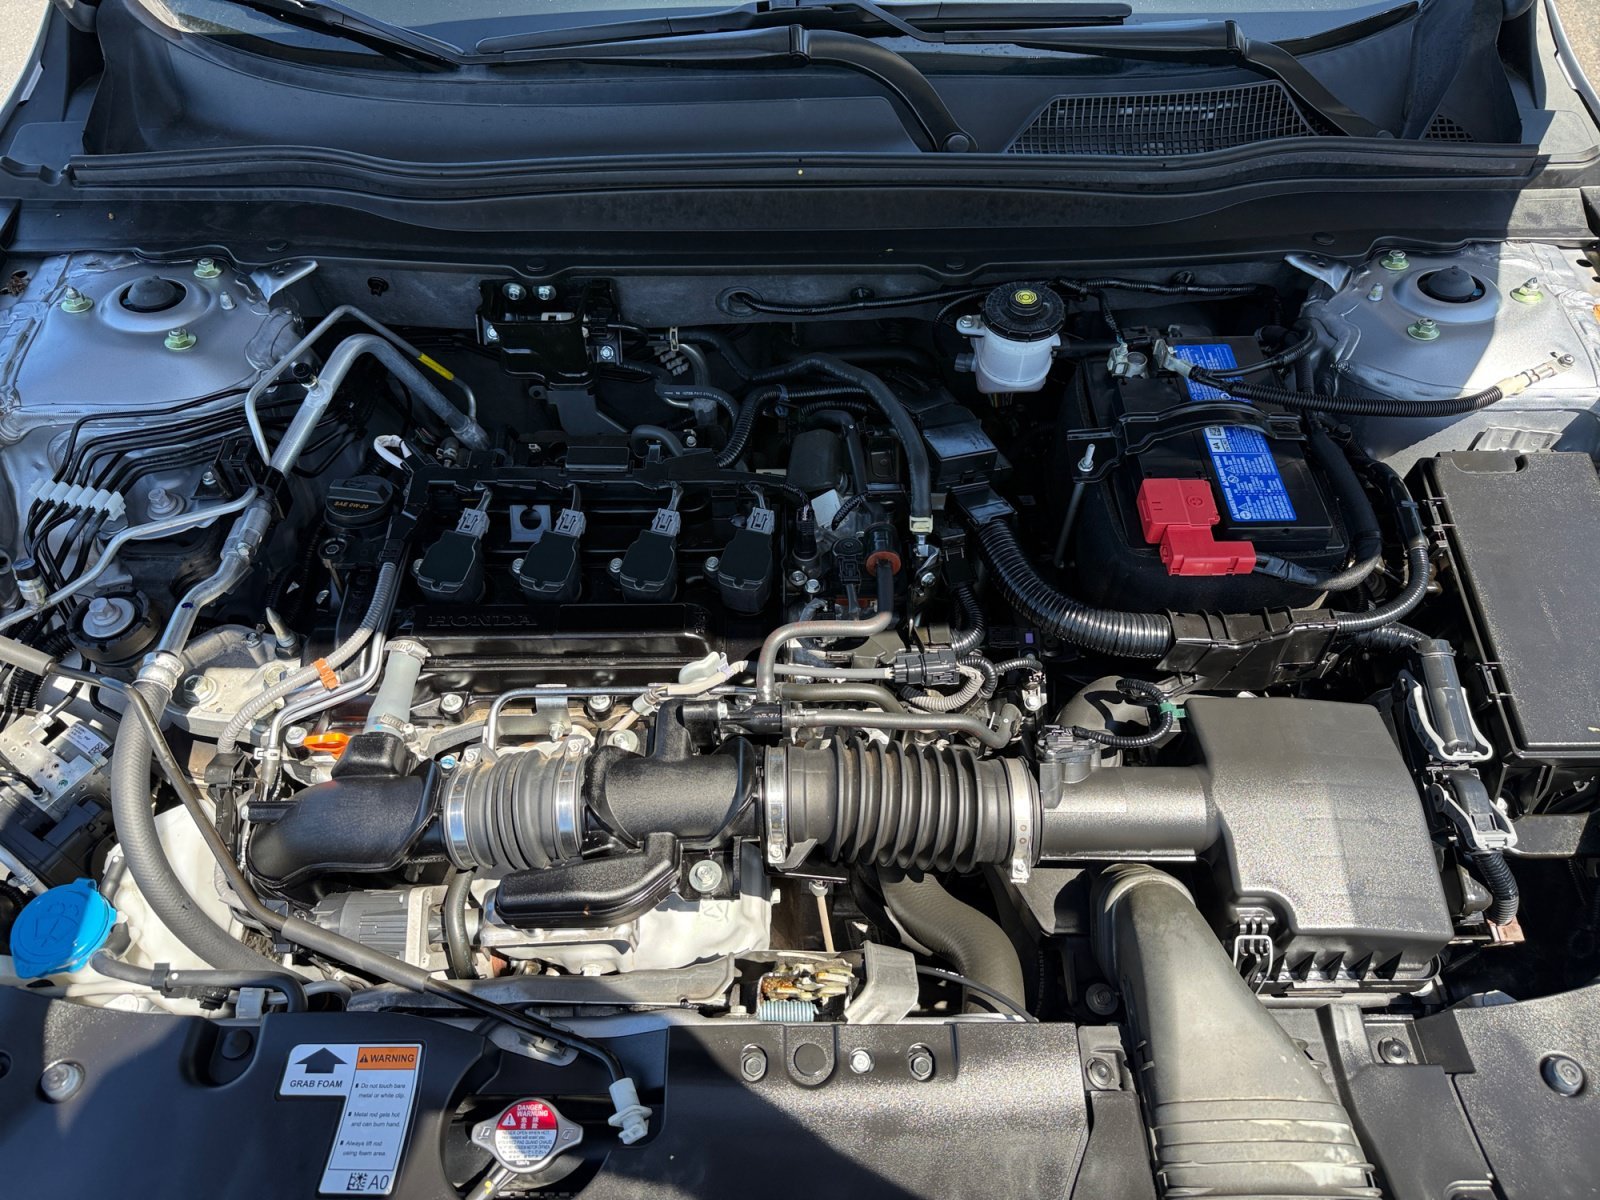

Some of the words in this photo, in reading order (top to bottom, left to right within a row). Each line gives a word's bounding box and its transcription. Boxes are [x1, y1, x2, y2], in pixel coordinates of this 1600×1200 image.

[426, 615, 538, 627] HONDA
[370, 1054, 415, 1063] WARNING
[289, 1080, 315, 1088] GRAB
[317, 1080, 343, 1088] FOAM
[367, 1174, 390, 1190] A0
